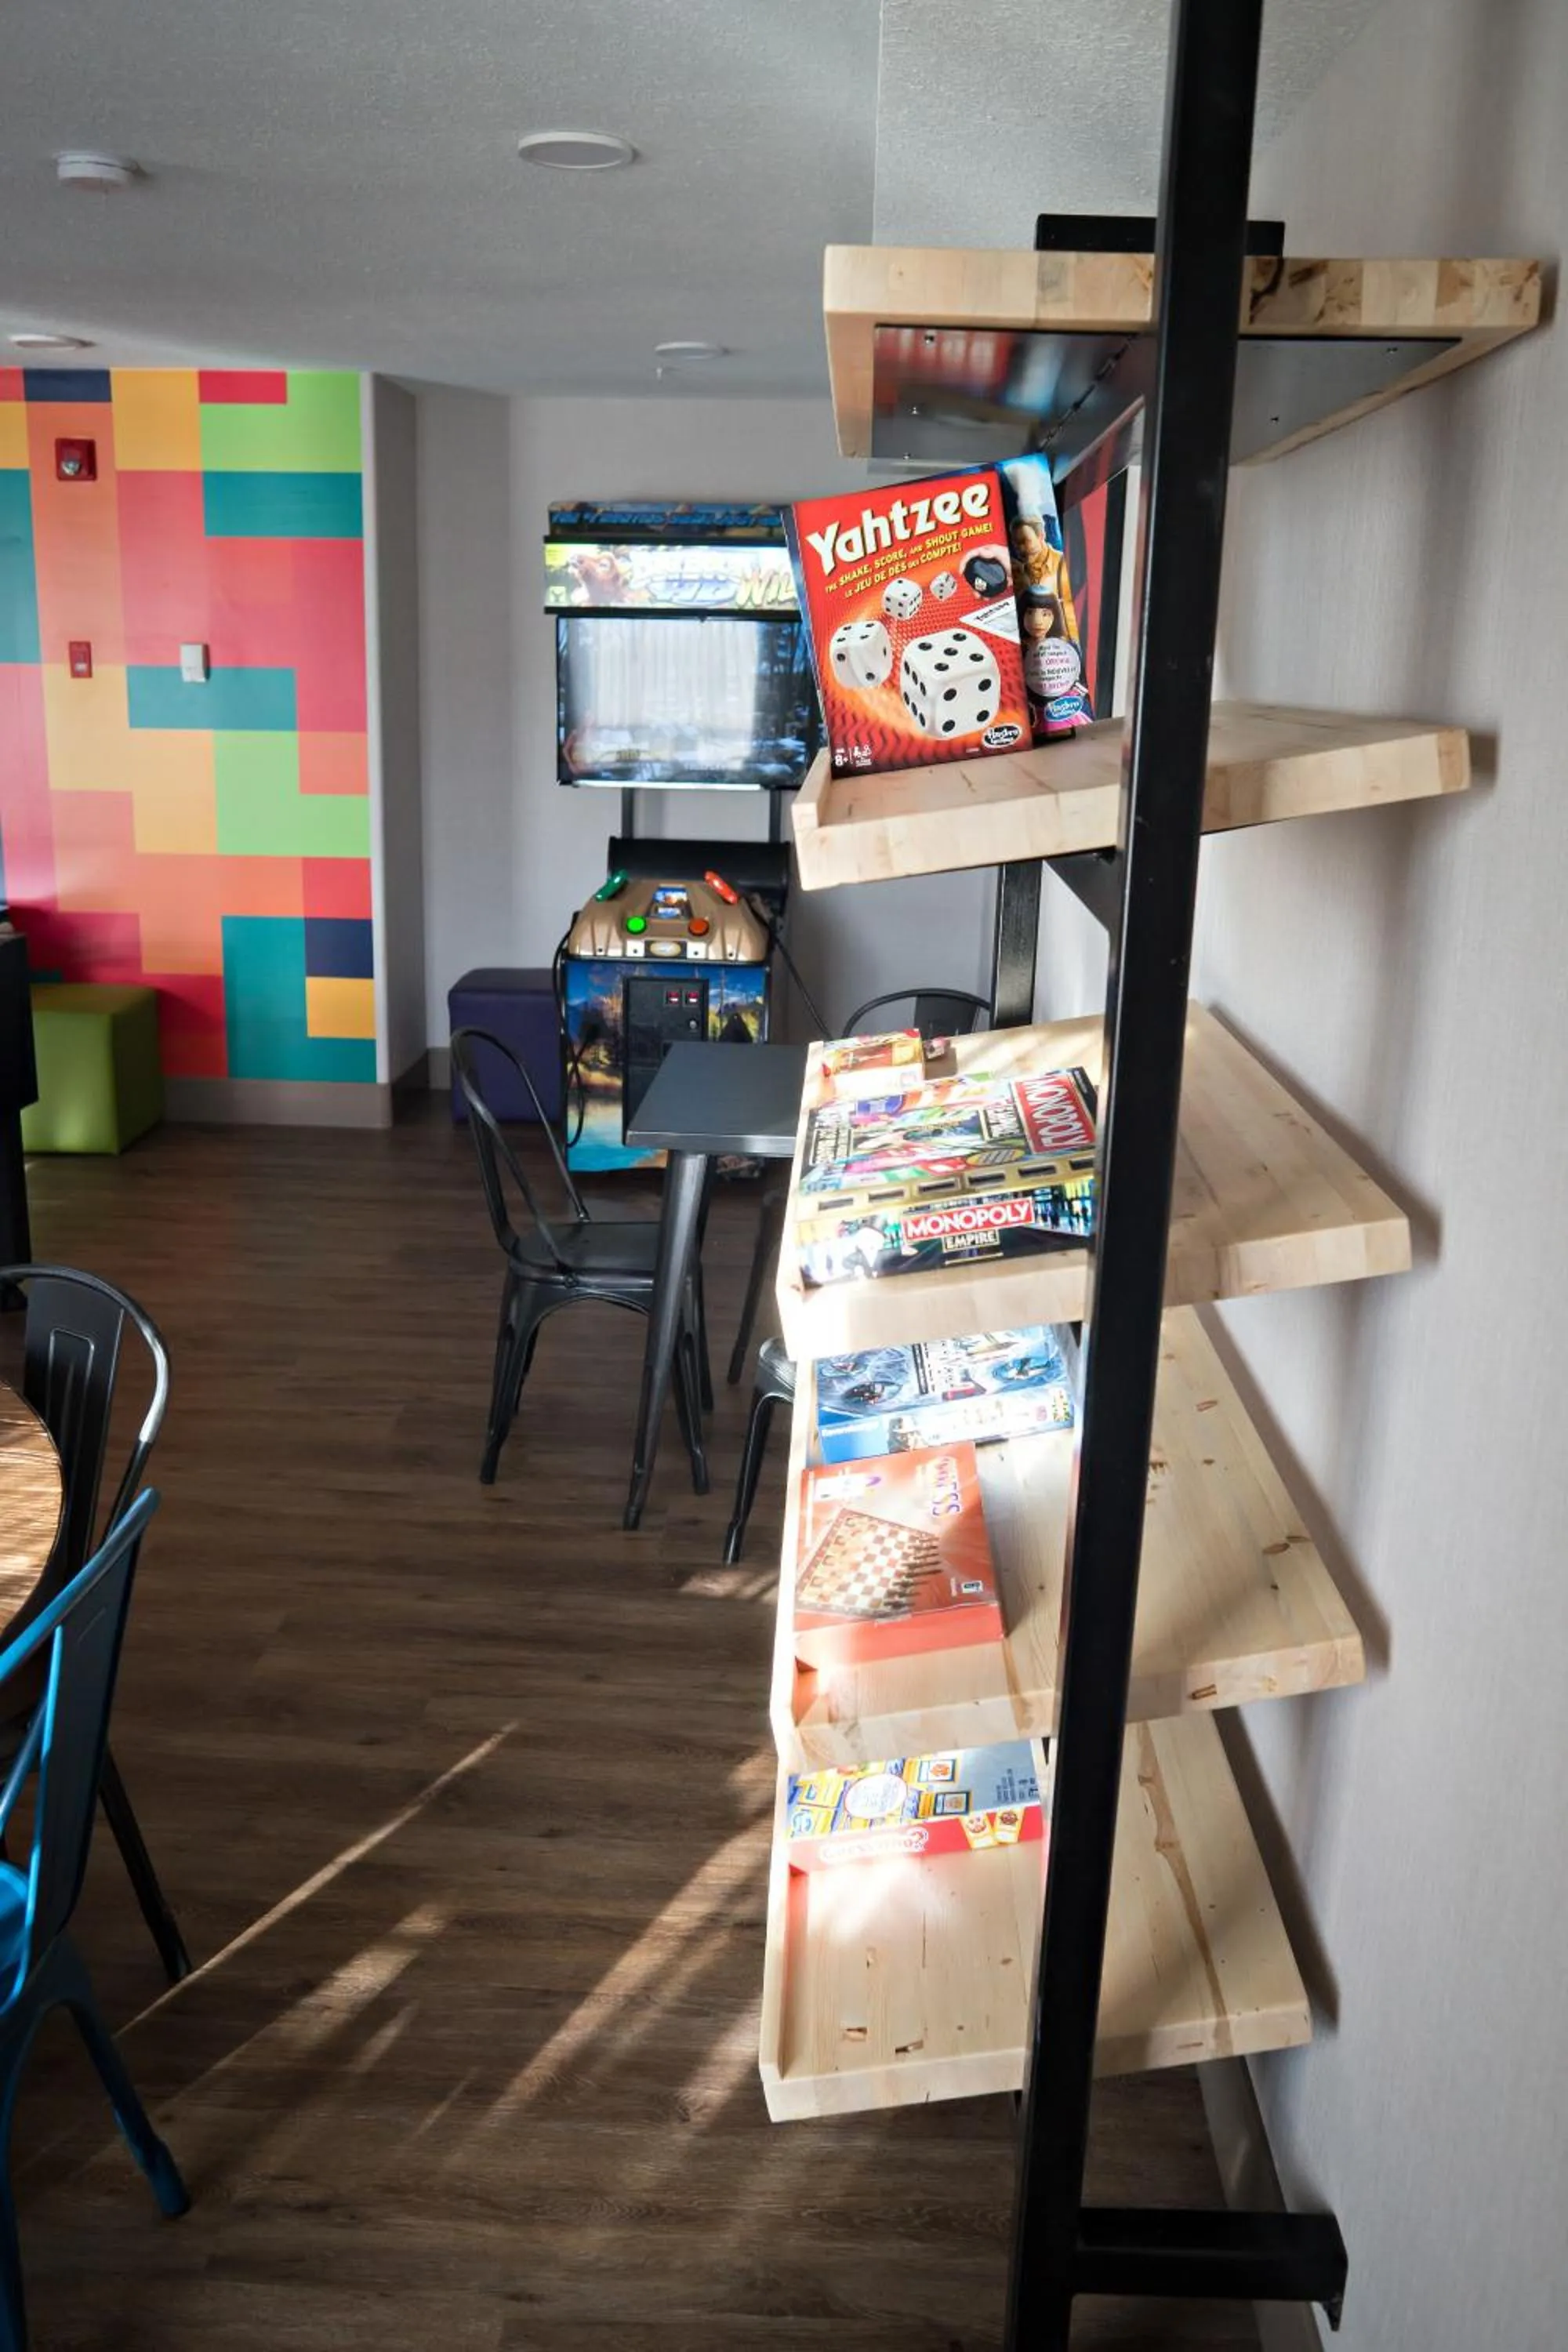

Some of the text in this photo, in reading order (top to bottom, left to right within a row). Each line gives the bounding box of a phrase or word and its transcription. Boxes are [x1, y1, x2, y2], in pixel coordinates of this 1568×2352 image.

[806, 483, 989, 576] Yahtzee
[839, 564, 873, 586] SHAKE,
[874, 550, 907, 568] SCORE,
[925, 531, 959, 549] SHOUT
[960, 523, 993, 539] GAME!
[1022, 1075, 1091, 1148] MONOPOLY
[906, 1202, 1030, 1237] MONOPOLY
[946, 1231, 996, 1250] EMPIRE
